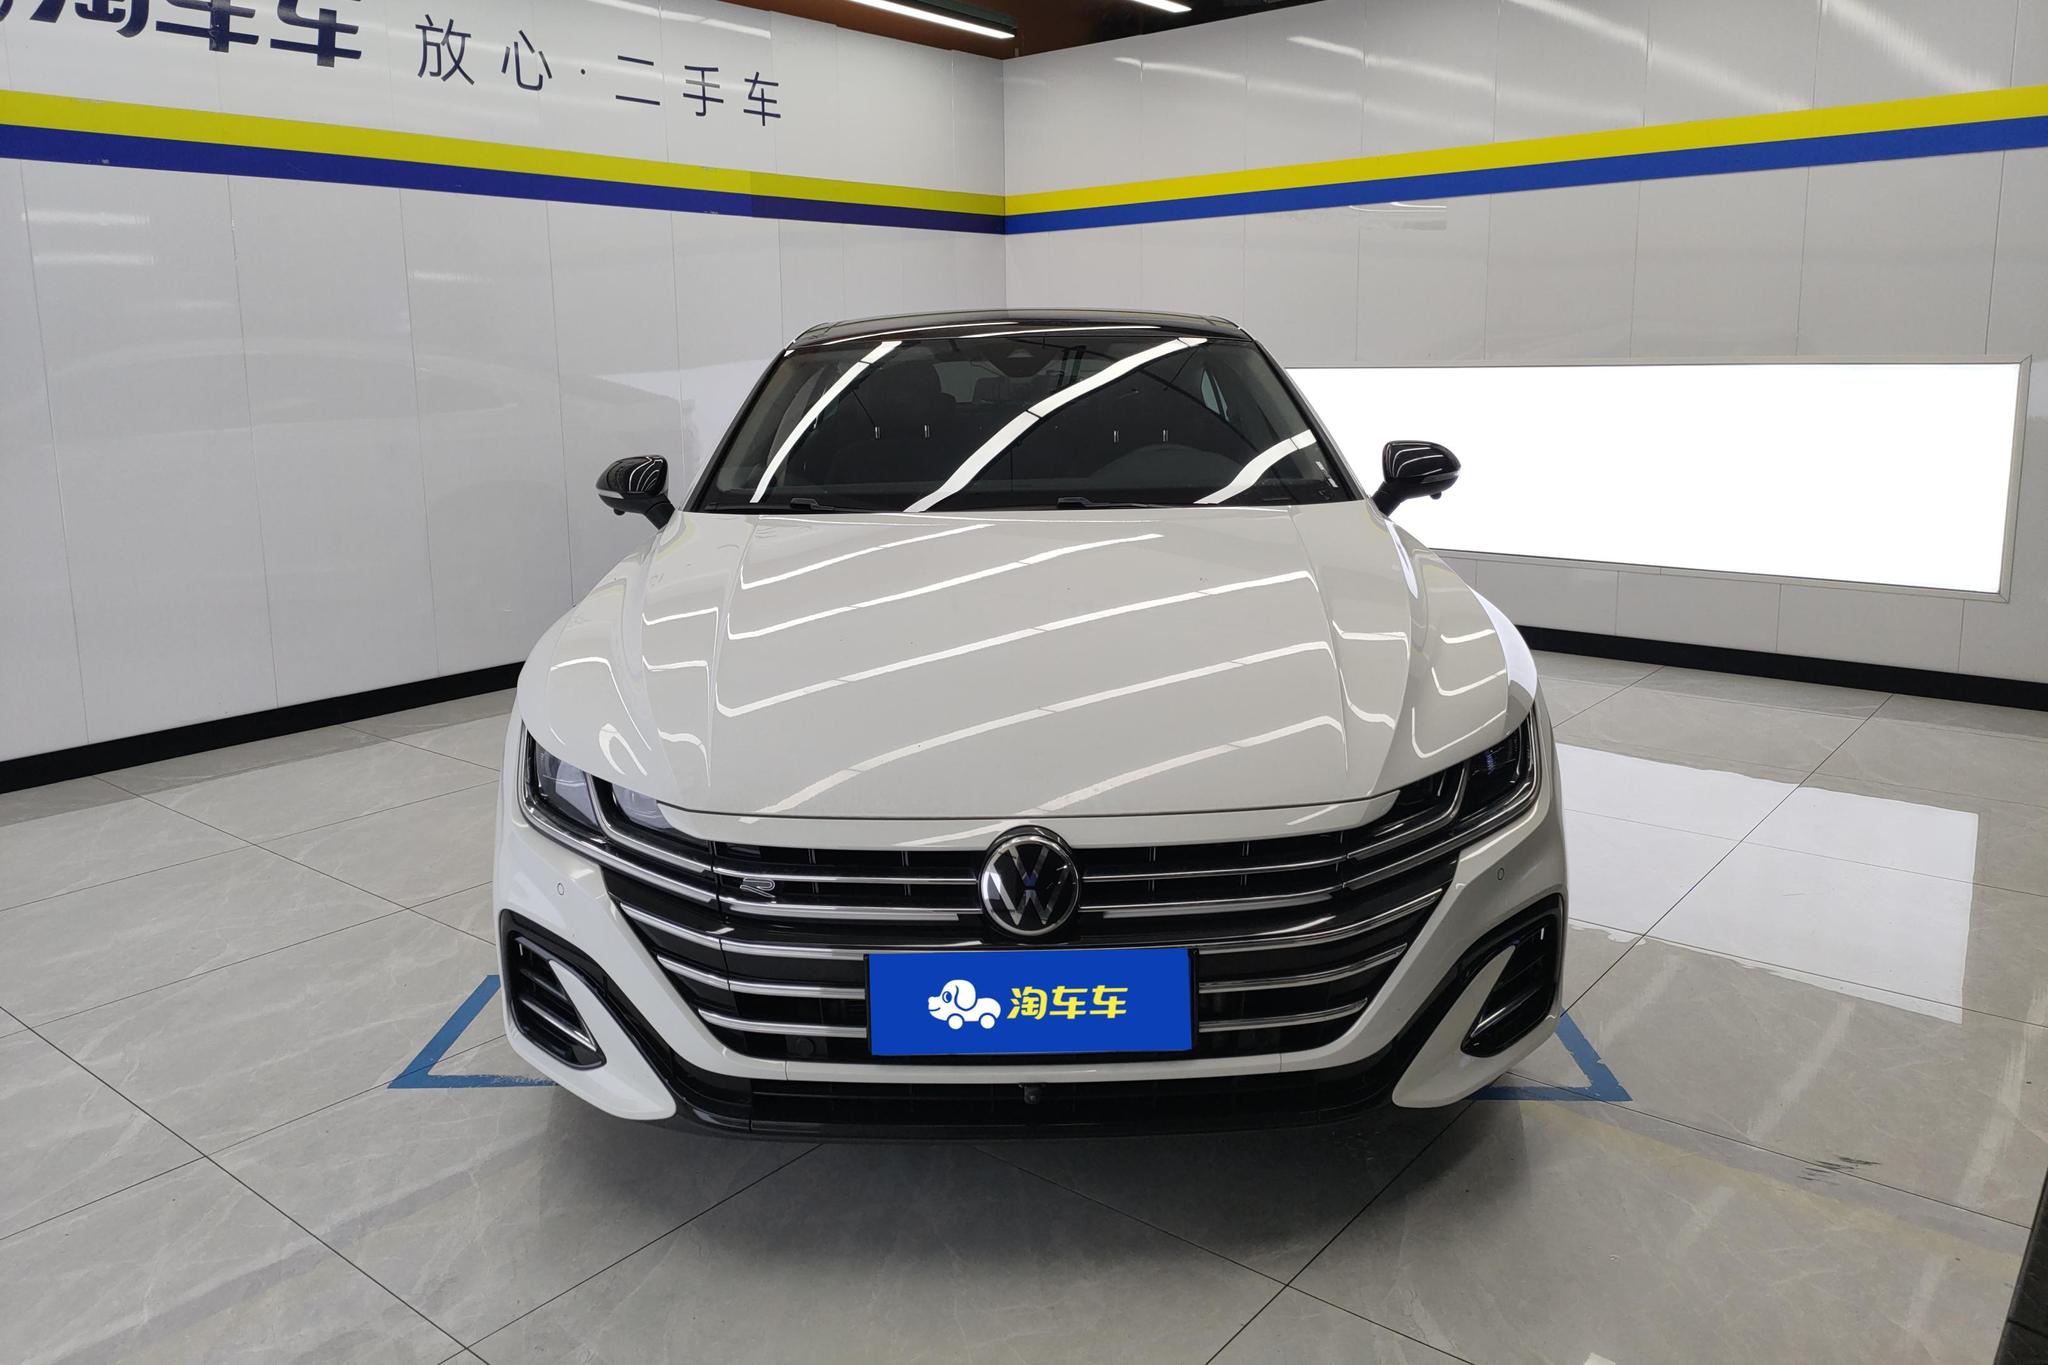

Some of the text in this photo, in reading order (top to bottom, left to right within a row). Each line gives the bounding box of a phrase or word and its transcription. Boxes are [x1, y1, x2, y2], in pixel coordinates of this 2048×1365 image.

[415, 14, 781, 127] 放心·二手车
[986, 841, 1074, 926] VW
